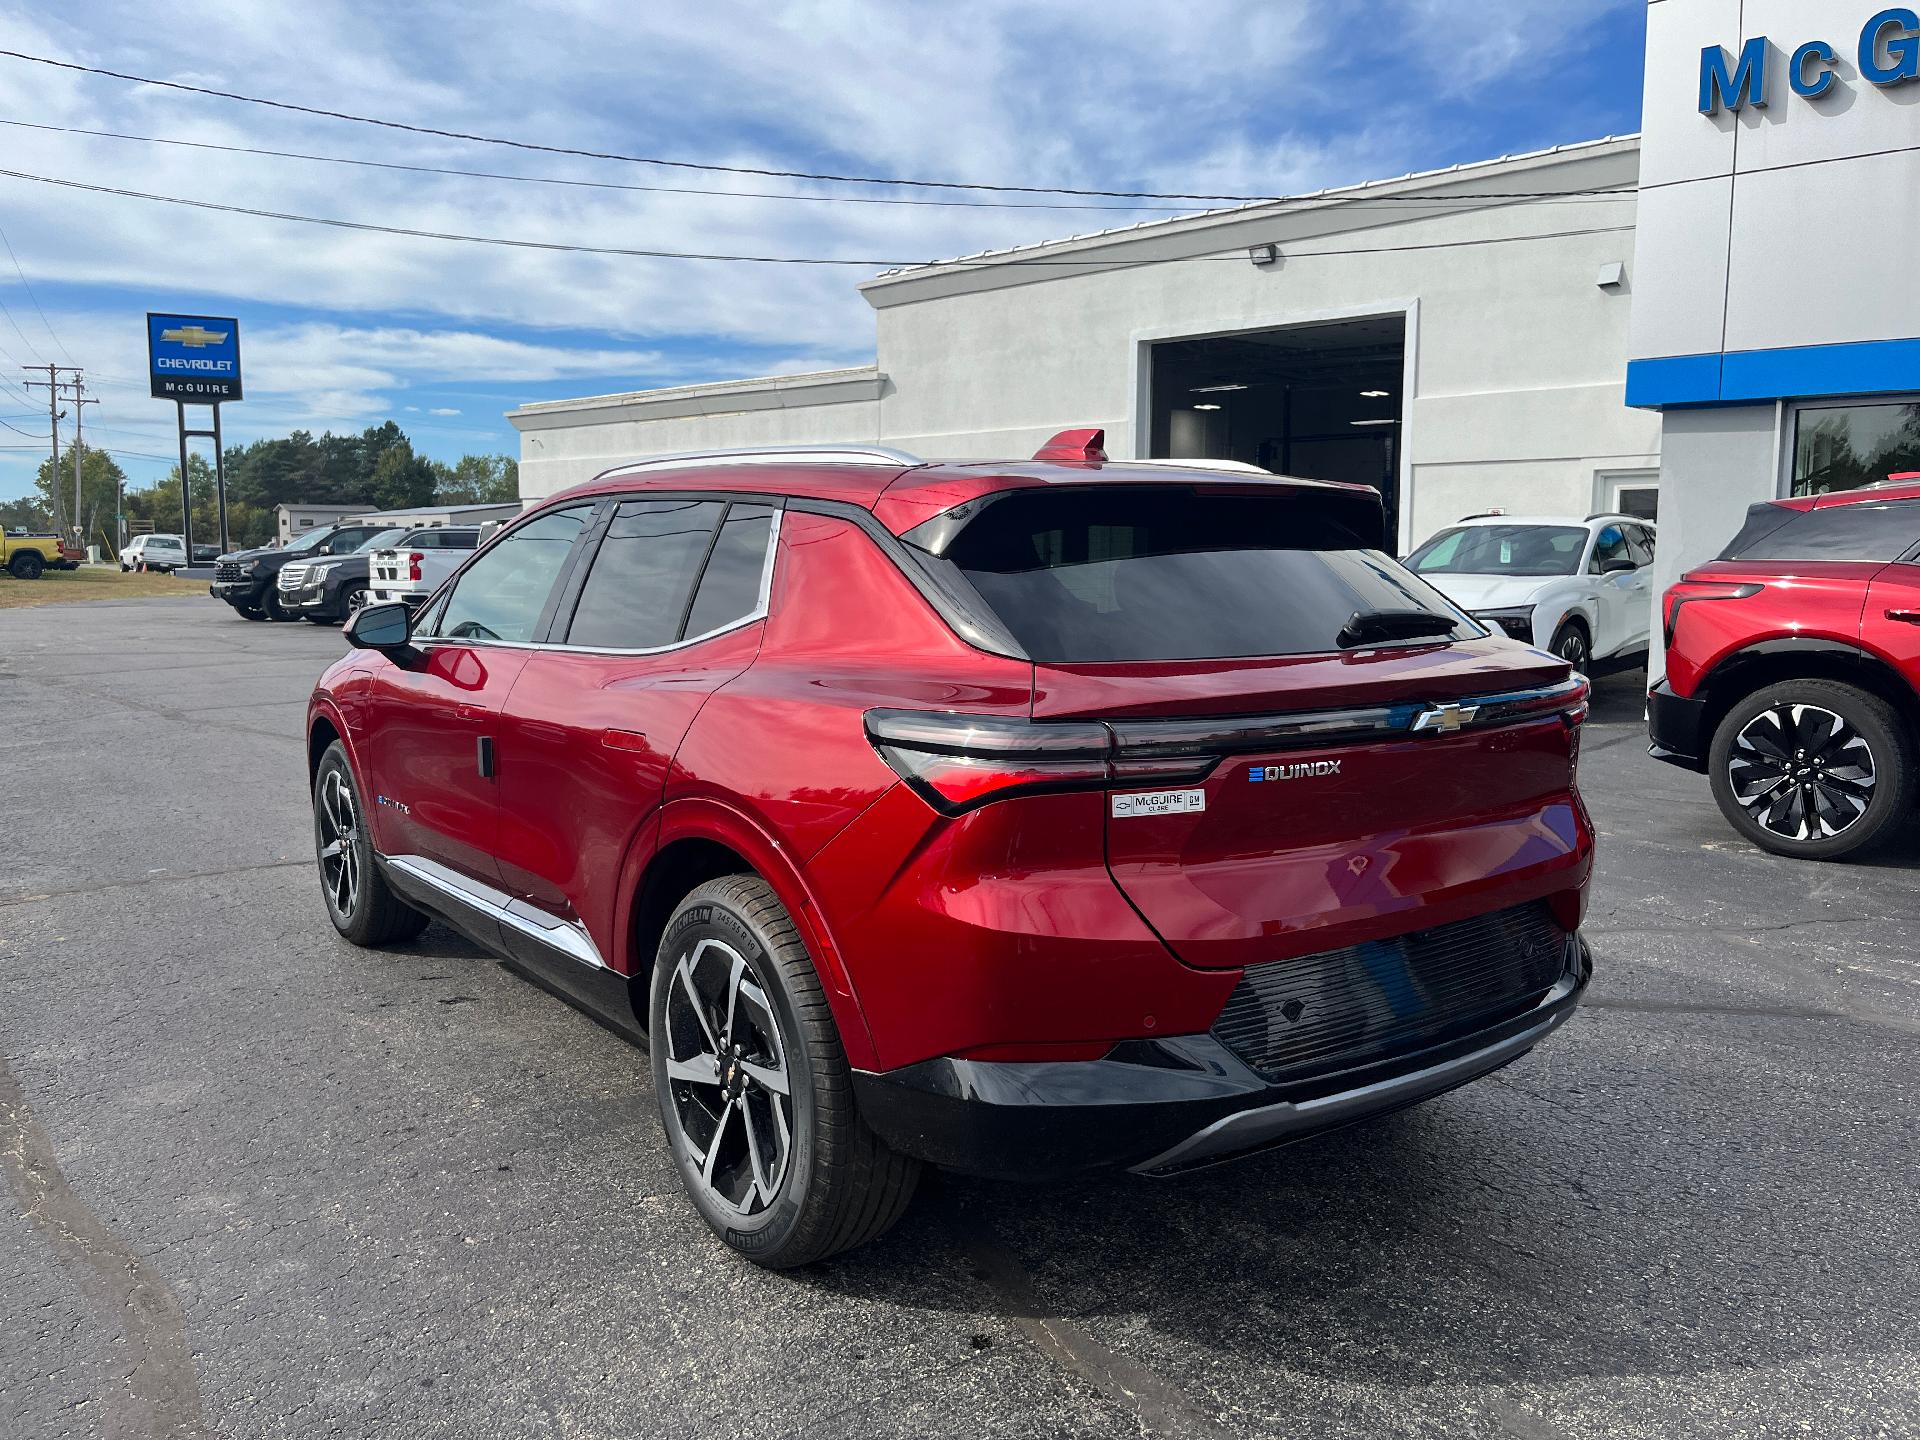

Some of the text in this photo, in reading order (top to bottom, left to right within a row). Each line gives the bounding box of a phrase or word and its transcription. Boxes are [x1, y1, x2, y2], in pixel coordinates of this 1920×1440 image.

[157, 358, 232, 371] CHEVROLET
[165, 382, 229, 394] McGUIRE
[1248, 760, 1341, 782] EQUINOX
[1135, 794, 1183, 807] McGUIRE
[1189, 795, 1200, 804] GM
[668, 909, 710, 941] MICHELIN
[718, 912, 741, 933] 245/55
[747, 940, 756, 951] 19
